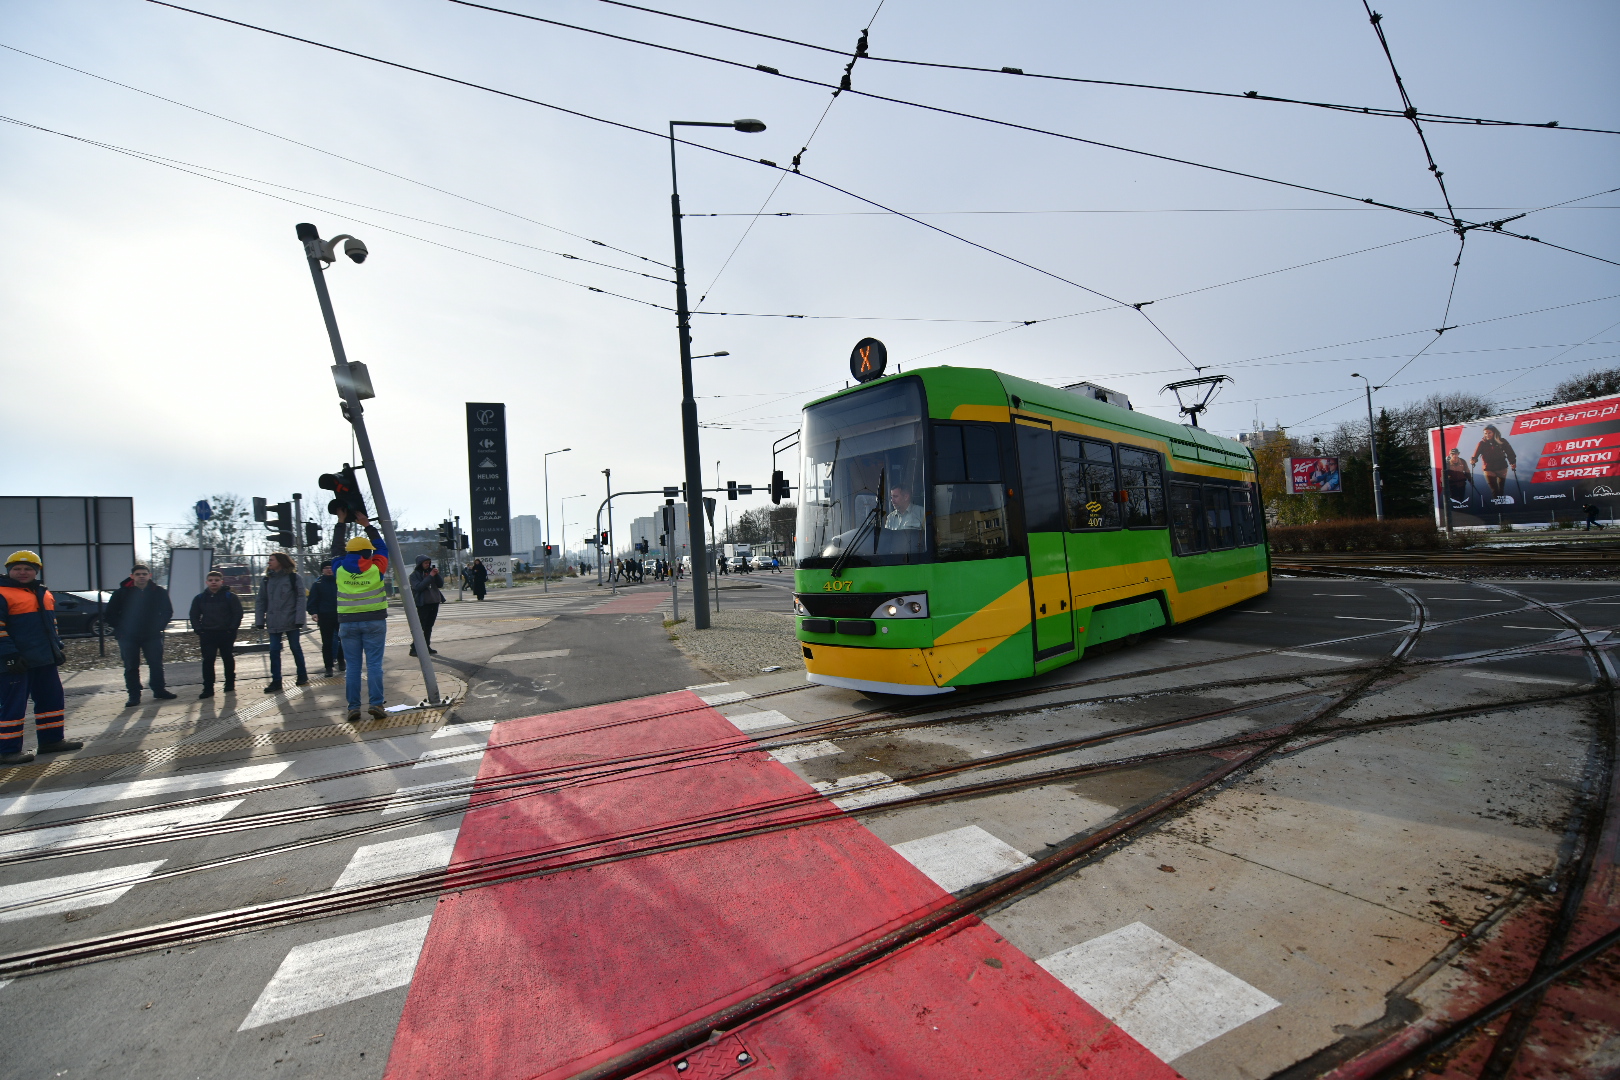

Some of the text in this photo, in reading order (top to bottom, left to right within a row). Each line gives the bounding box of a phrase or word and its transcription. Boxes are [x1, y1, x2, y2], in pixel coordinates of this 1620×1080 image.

[859, 345, 872, 373] X
[1520, 404, 1618, 429] sportano.pl
[1565, 437, 1603, 451] BUTY
[1560, 451, 1612, 465] KURTKI
[1556, 465, 1611, 478] SPRZĘT
[1087, 517, 1103, 527] 407
[823, 580, 853, 592] 407
